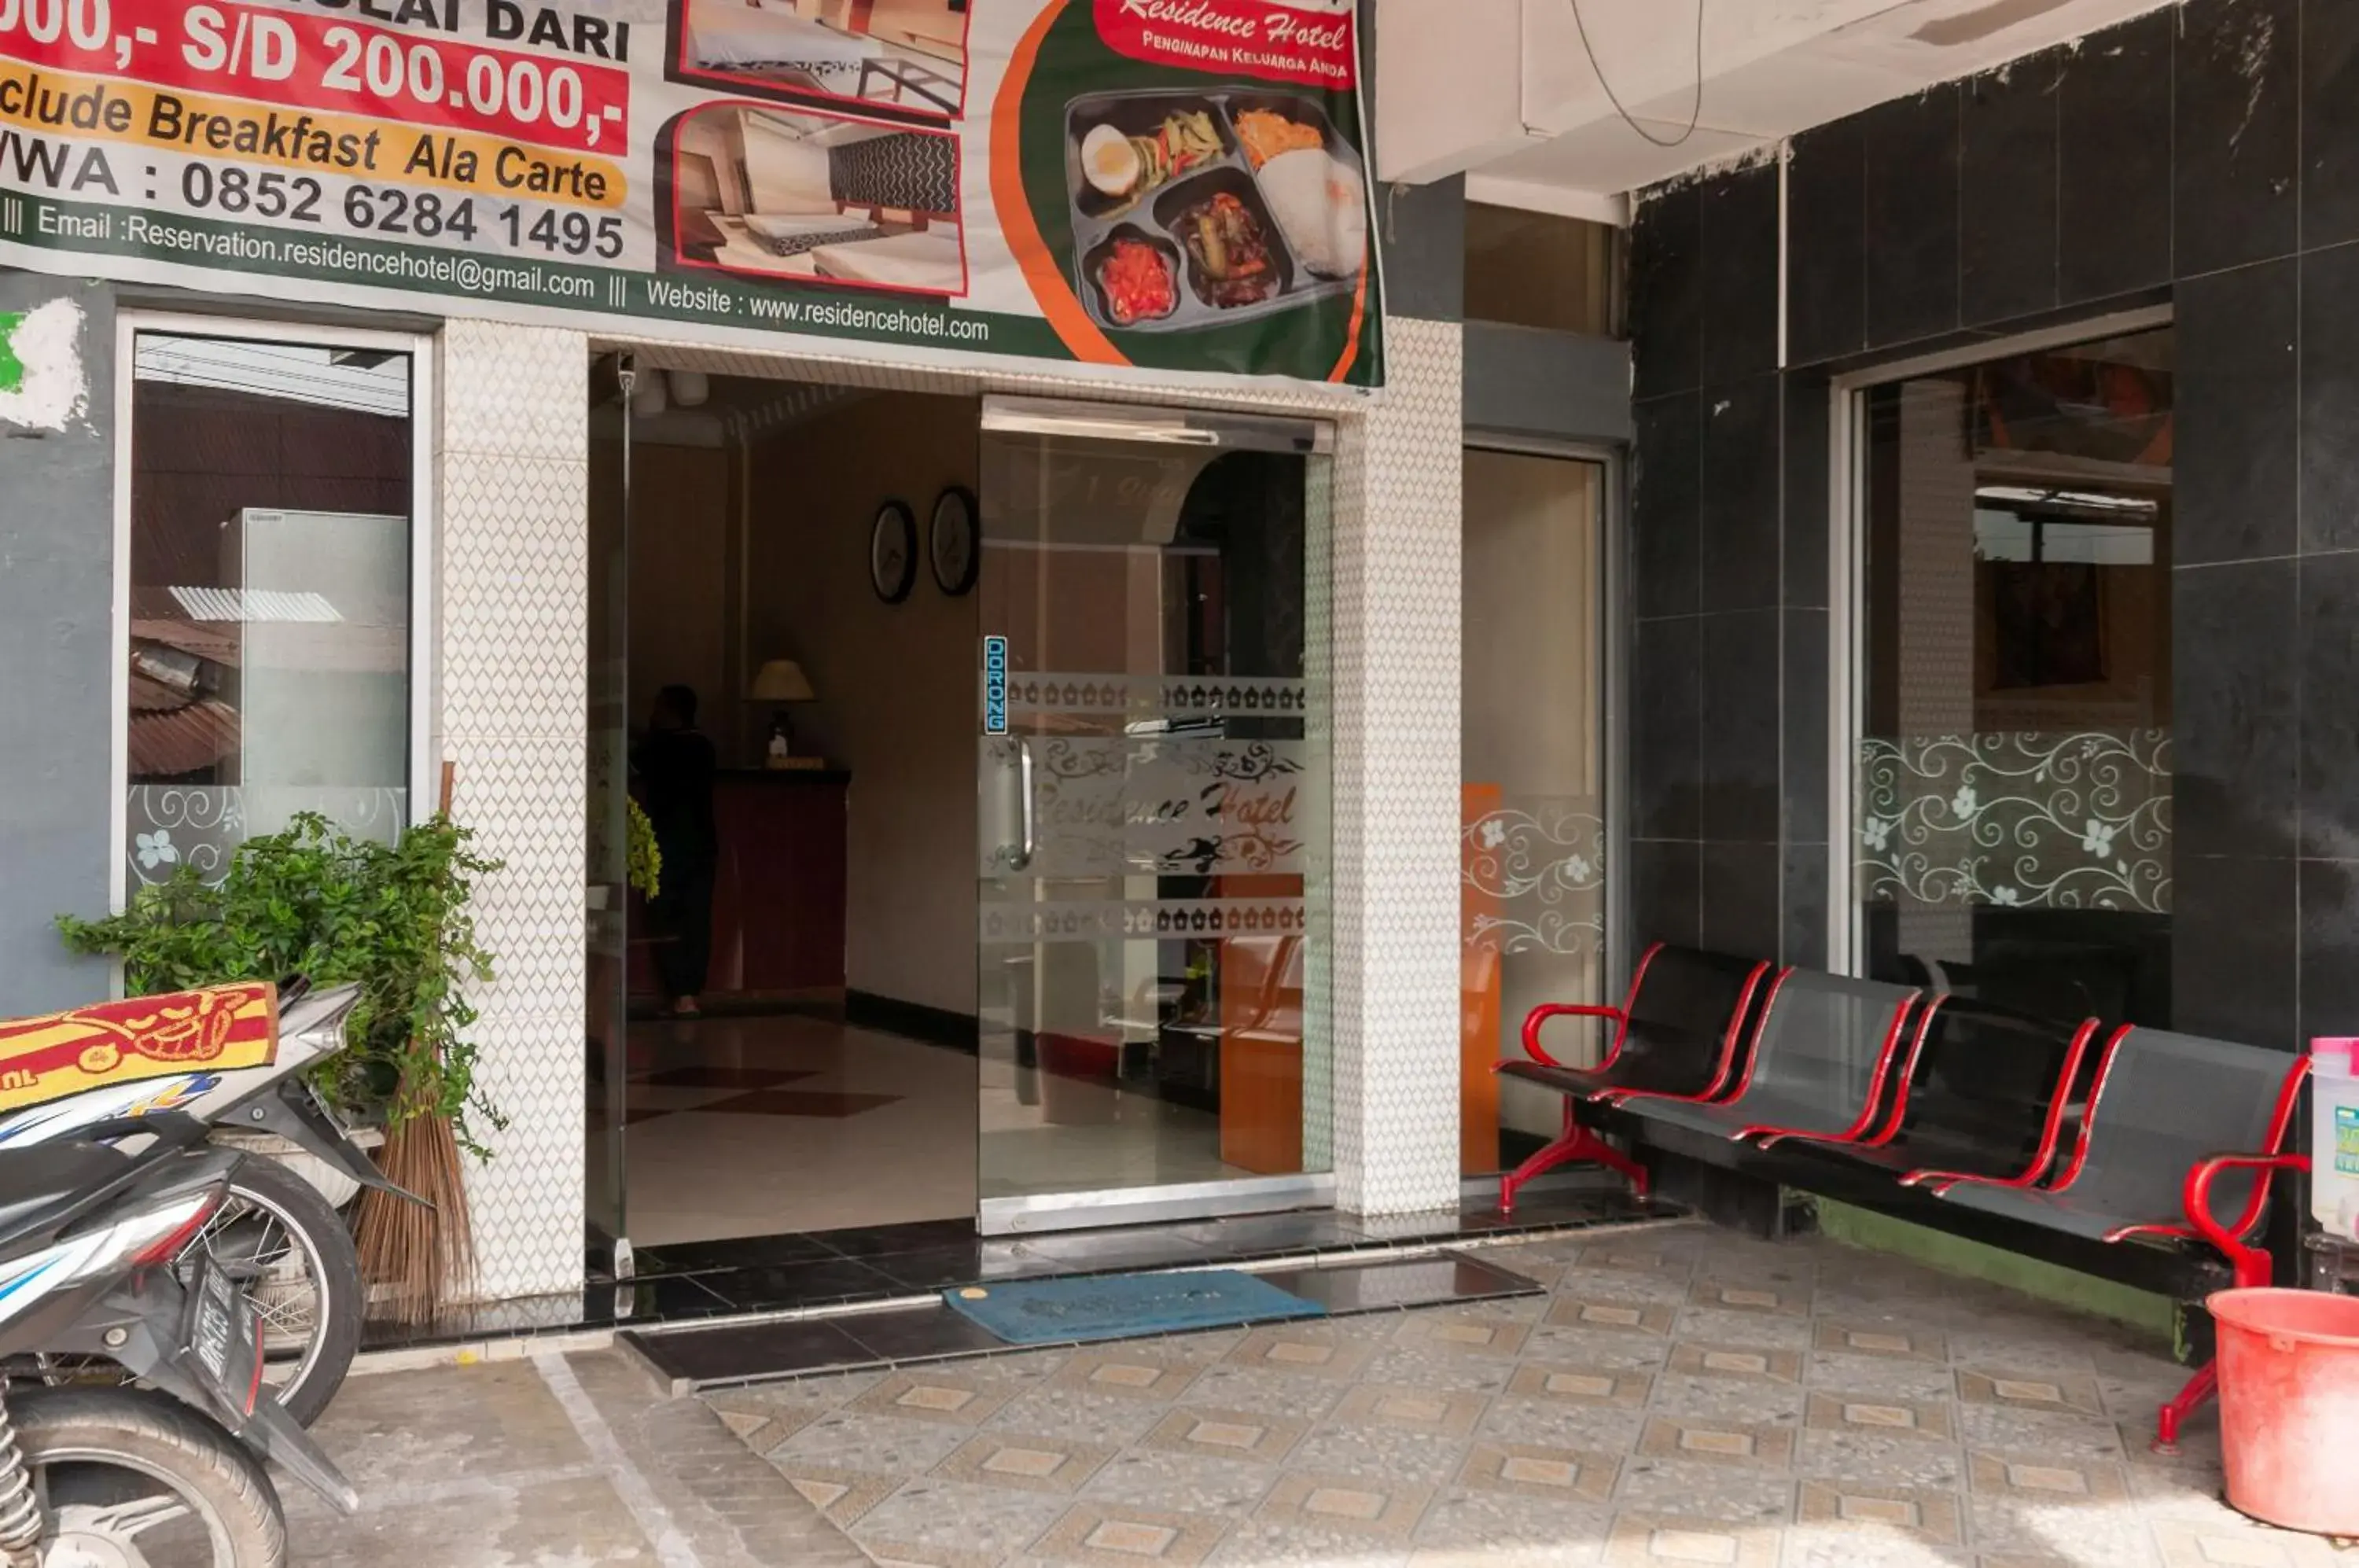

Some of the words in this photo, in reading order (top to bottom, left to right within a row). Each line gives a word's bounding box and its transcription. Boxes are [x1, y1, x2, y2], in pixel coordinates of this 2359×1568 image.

[485, 0, 629, 63] DARI
[1120, 0, 1257, 38] Residence
[1264, 13, 1347, 51] Hotel
[1143, 30, 1228, 62] PENGINAPAN
[1231, 47, 1307, 72] KELUARGA
[181, 6, 297, 81] S/D
[322, 27, 622, 147] 200.000,-
[148, 93, 381, 171] Breakfast
[403, 134, 478, 183] Ala
[495, 146, 606, 201] Carte
[38, 205, 111, 240] Email
[182, 162, 322, 223] 0852
[344, 184, 477, 241] 6284
[499, 204, 624, 259] 1495
[646, 279, 731, 313] Website
[749, 294, 989, 341] www.residencehotel.com
[988, 640, 1004, 730] DORONG
